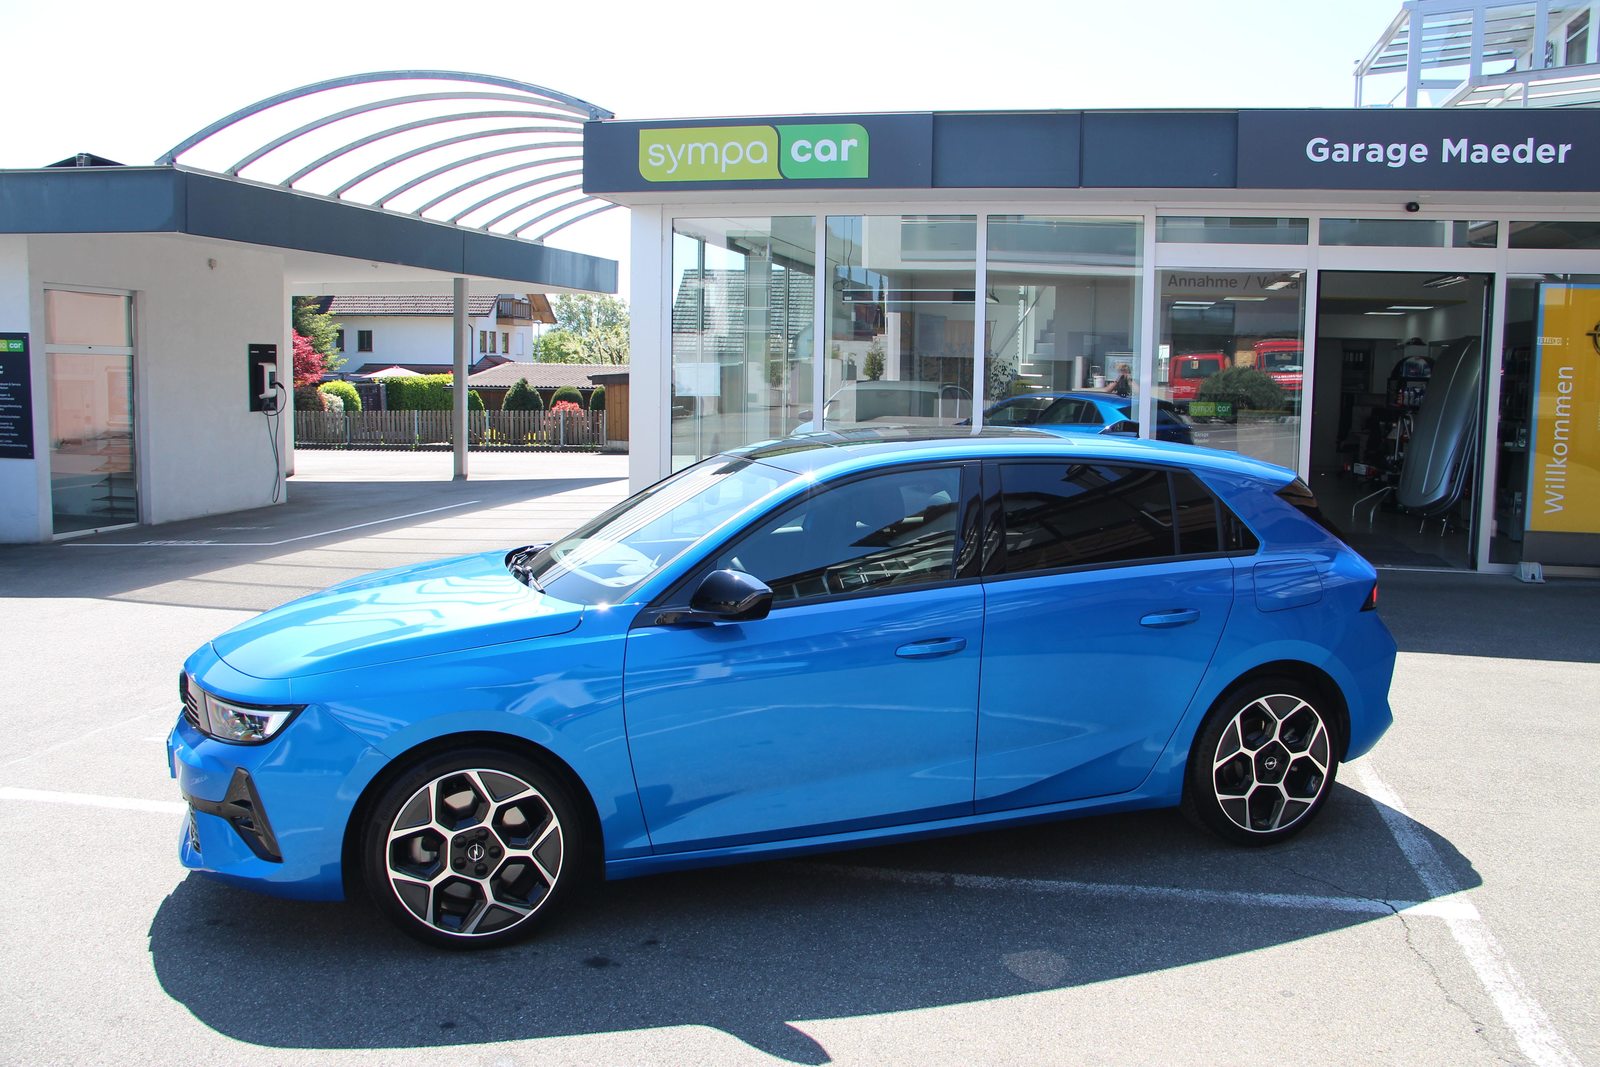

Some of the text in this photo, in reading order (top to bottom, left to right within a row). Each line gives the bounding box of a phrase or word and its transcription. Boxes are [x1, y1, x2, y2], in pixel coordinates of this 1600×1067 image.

[648, 138, 858, 174] sympa car
[1306, 137, 1571, 168] Garage Maeder
[1168, 274, 1238, 288] Annahme
[1543, 366, 1574, 514] Willkommen
